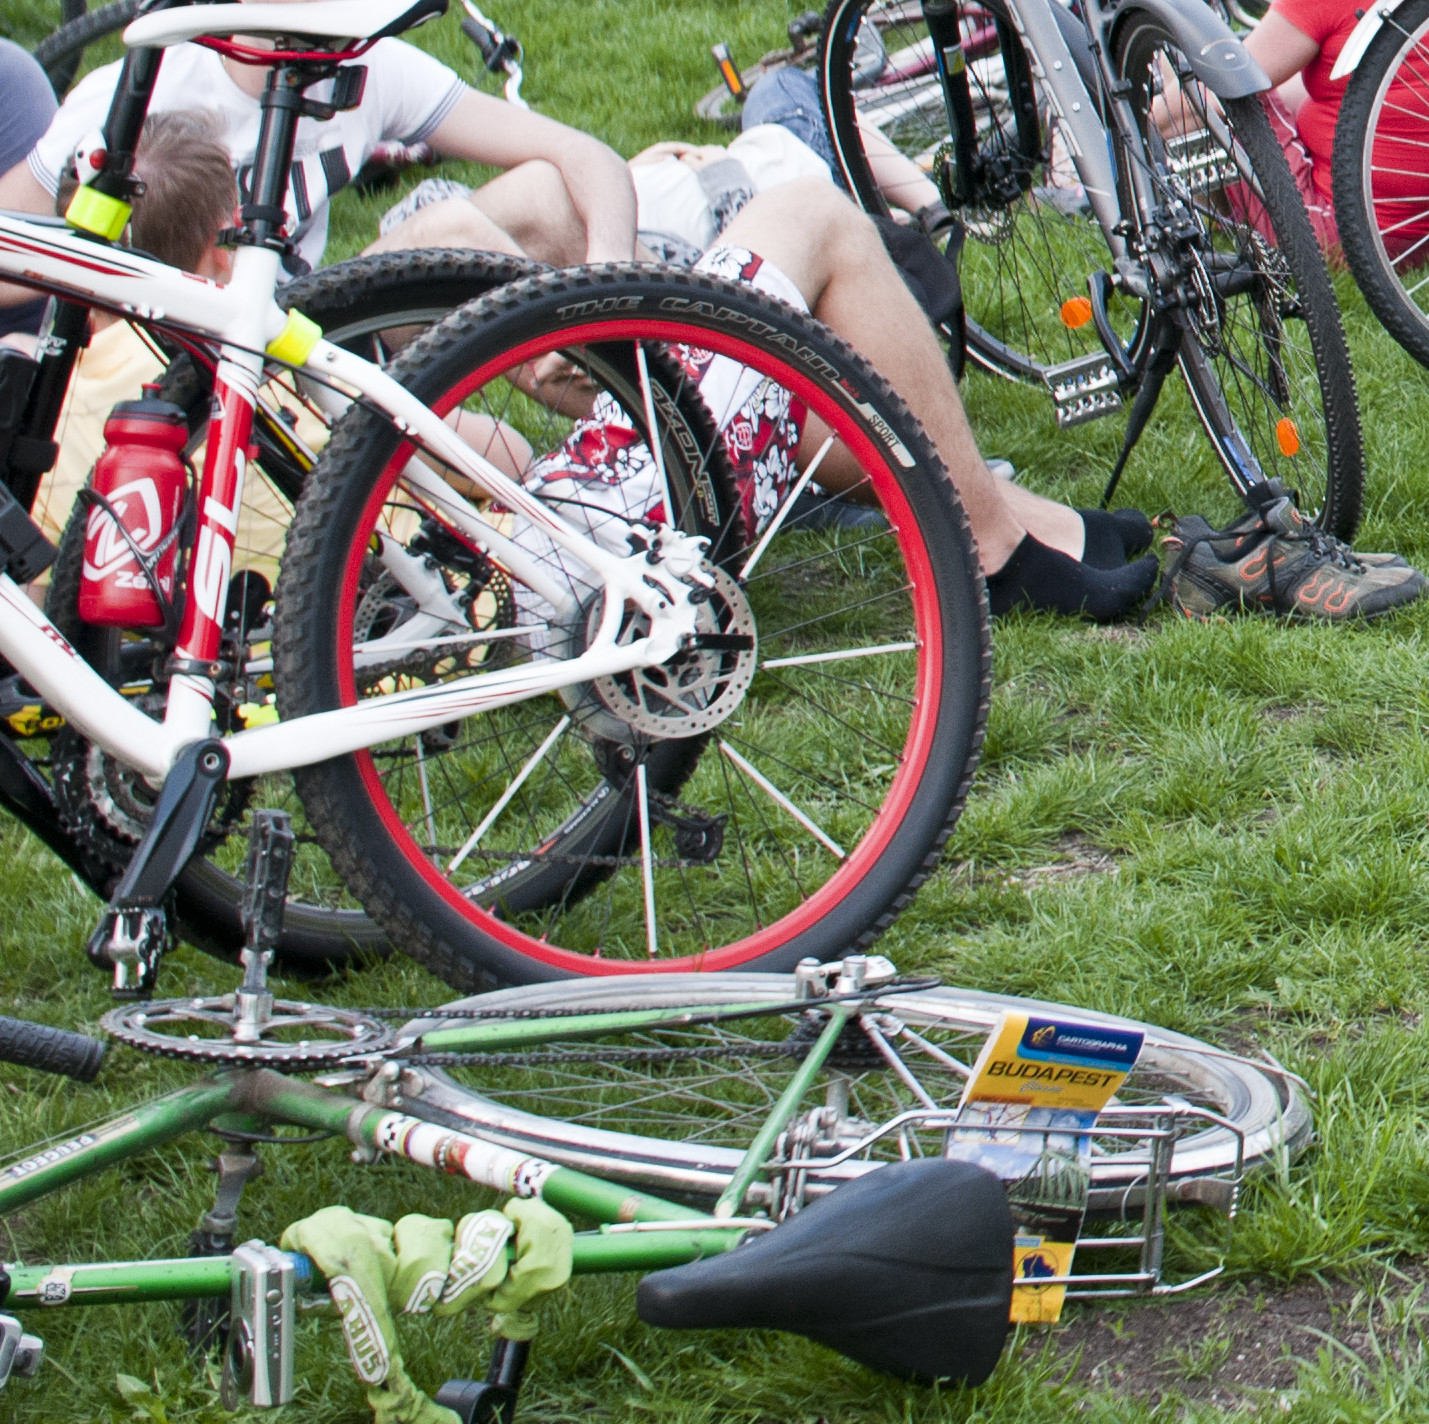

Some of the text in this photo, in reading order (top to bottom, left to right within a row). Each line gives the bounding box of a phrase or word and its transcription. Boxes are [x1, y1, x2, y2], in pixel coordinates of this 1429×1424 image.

[556, 296, 842, 382] THE CAPTAIN
[868, 412, 902, 449] SPORT
[987, 1060, 1118, 1088] BUDAPEST
[10, 1133, 98, 1179] PEUGEOT
[338, 1297, 382, 1376] ABUS
